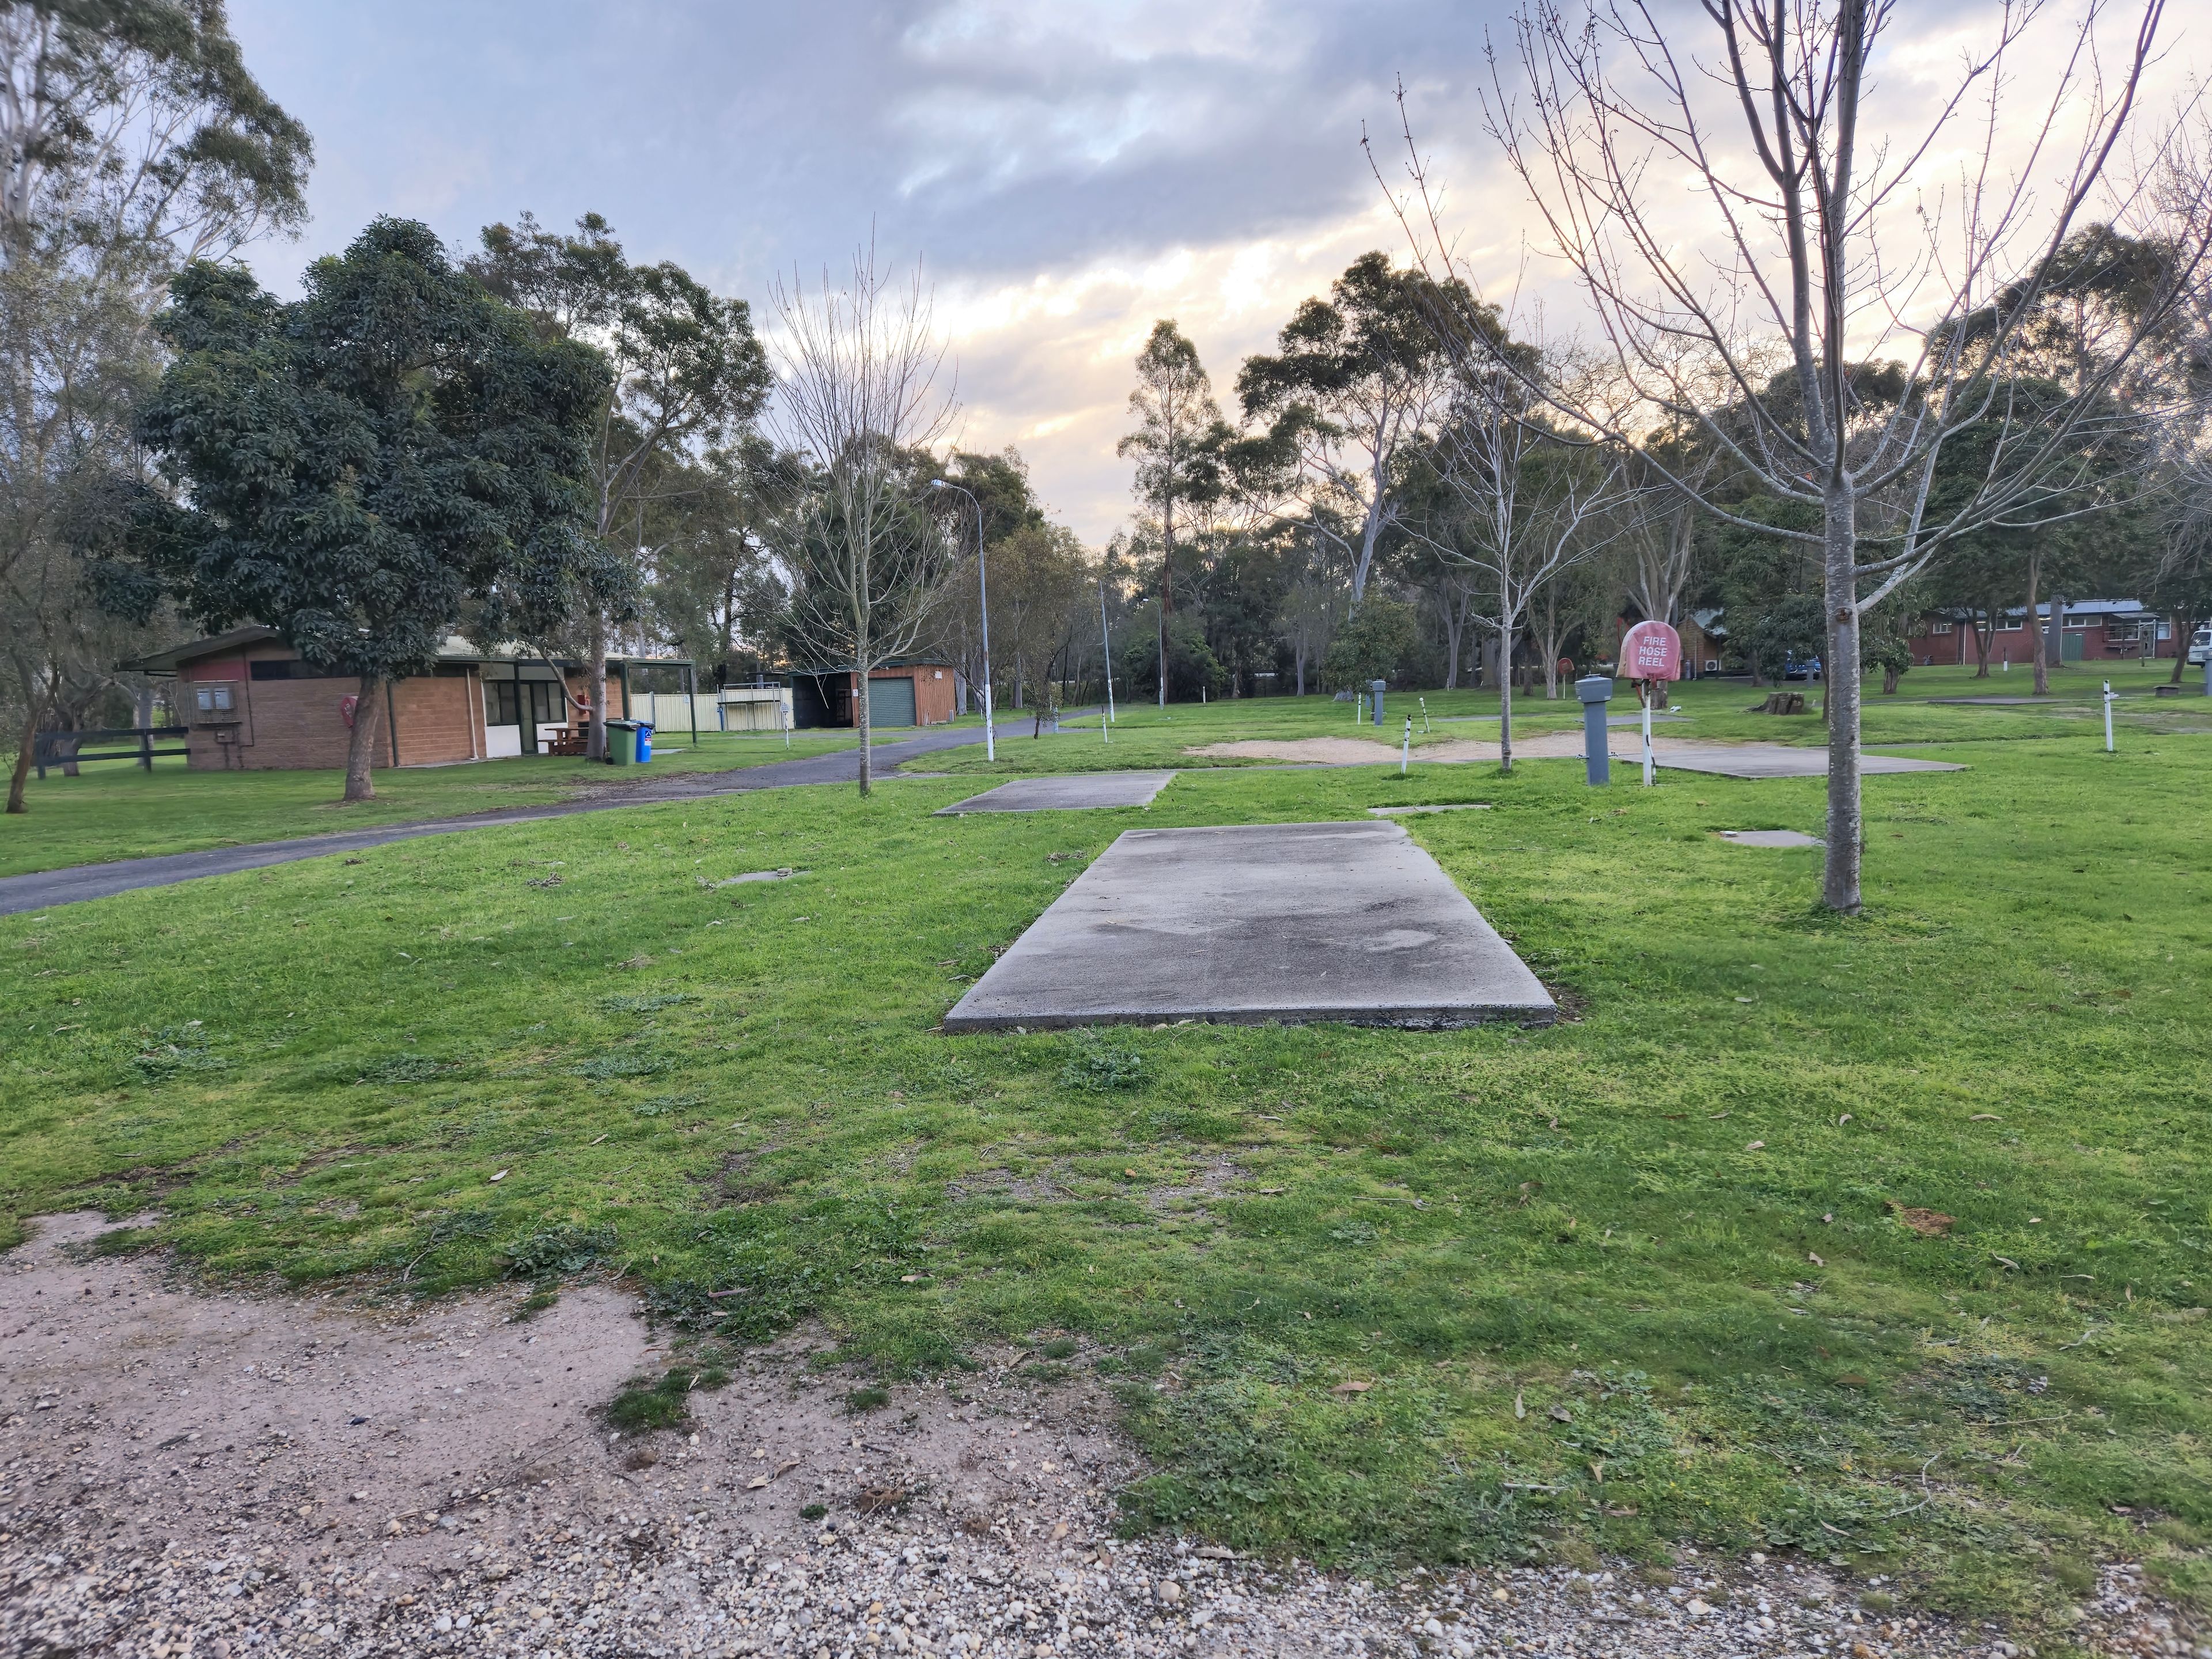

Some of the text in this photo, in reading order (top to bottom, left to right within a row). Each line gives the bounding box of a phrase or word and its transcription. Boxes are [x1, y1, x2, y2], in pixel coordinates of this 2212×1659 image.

[1643, 636, 1666, 646] FIRE
[1639, 646, 1668, 656] HOSE
[1638, 656, 1665, 666] REEL
